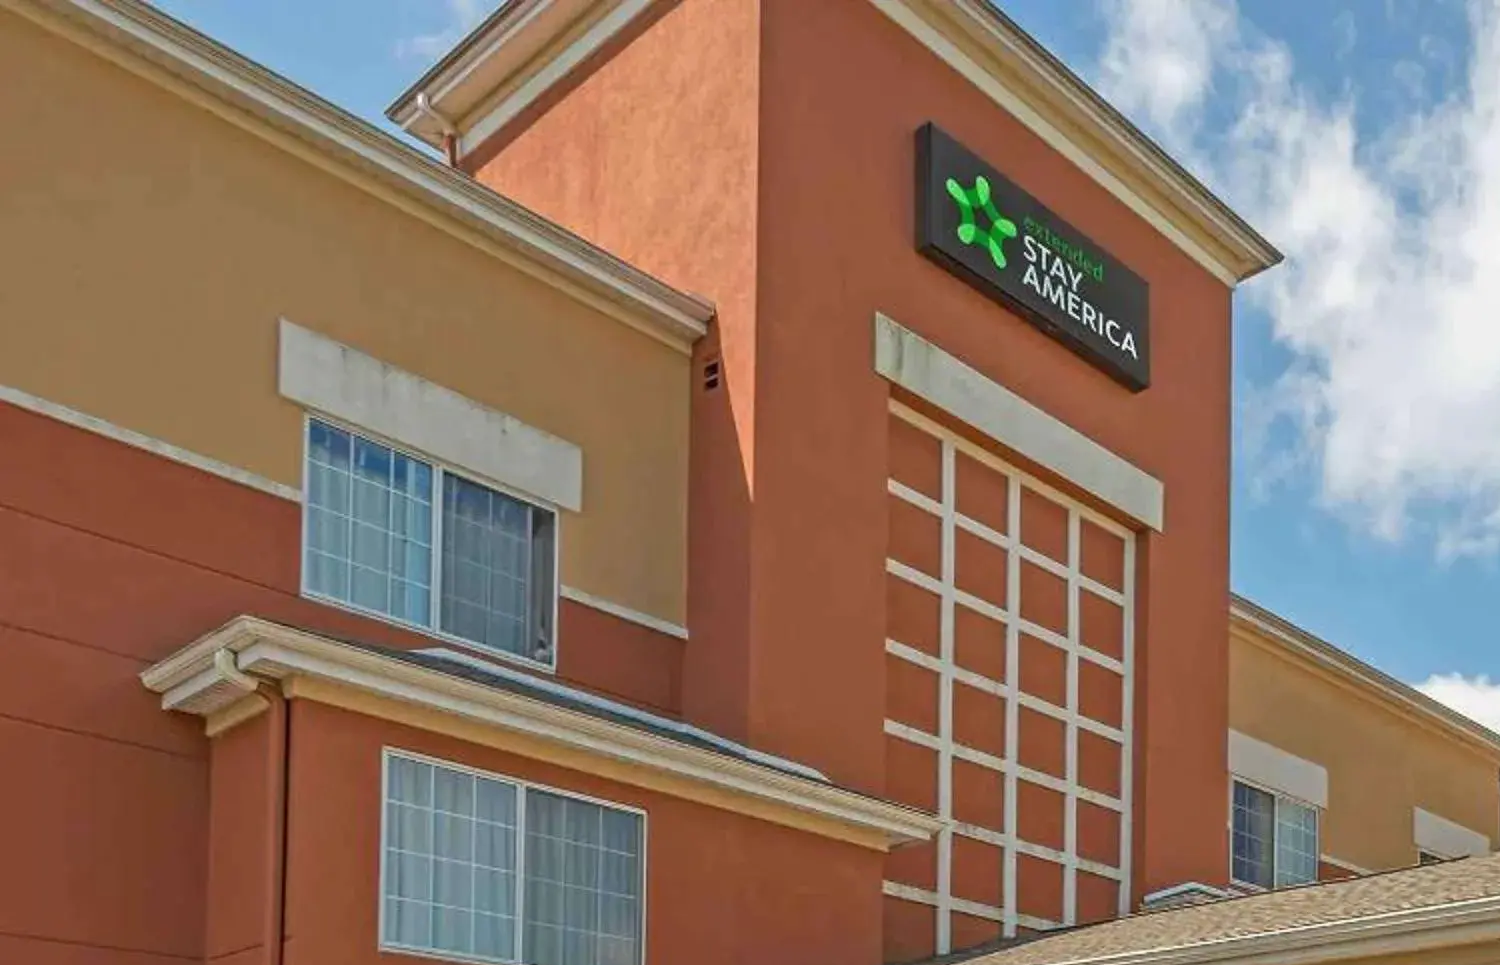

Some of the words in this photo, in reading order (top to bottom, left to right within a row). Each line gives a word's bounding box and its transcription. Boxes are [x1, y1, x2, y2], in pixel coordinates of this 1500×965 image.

[1023, 217, 1103, 282] extended
[1023, 235, 1082, 292] STAY
[1022, 264, 1138, 360] AMERICA
